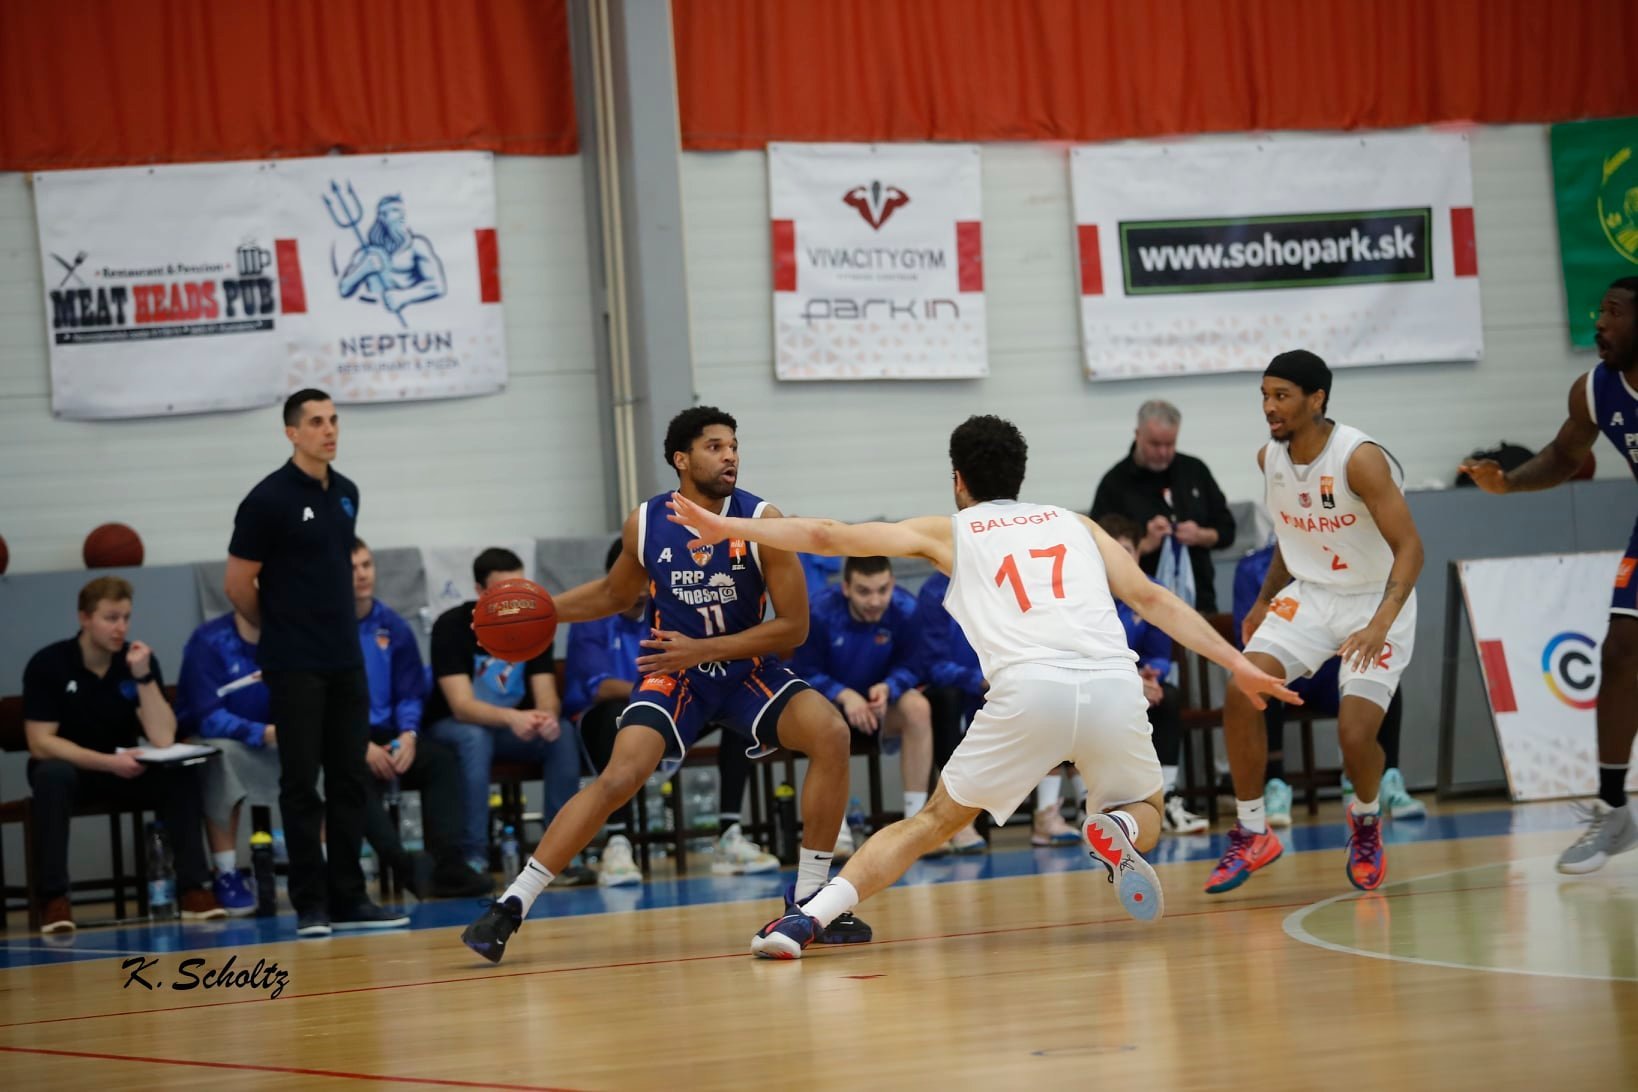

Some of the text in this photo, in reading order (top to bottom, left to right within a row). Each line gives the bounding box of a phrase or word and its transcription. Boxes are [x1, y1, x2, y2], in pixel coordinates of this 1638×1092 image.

[807, 249, 946, 268] VIVACITYGYM
[1138, 225, 1415, 271] www.sohopark.sk
[51, 277, 275, 329] MEAT HEADS PUB
[339, 330, 452, 357] NEPTUN
[970, 510, 1059, 534] BALOGH
[670, 570, 705, 586] PRP
[994, 543, 1068, 614] 17
[697, 604, 726, 637] 11
